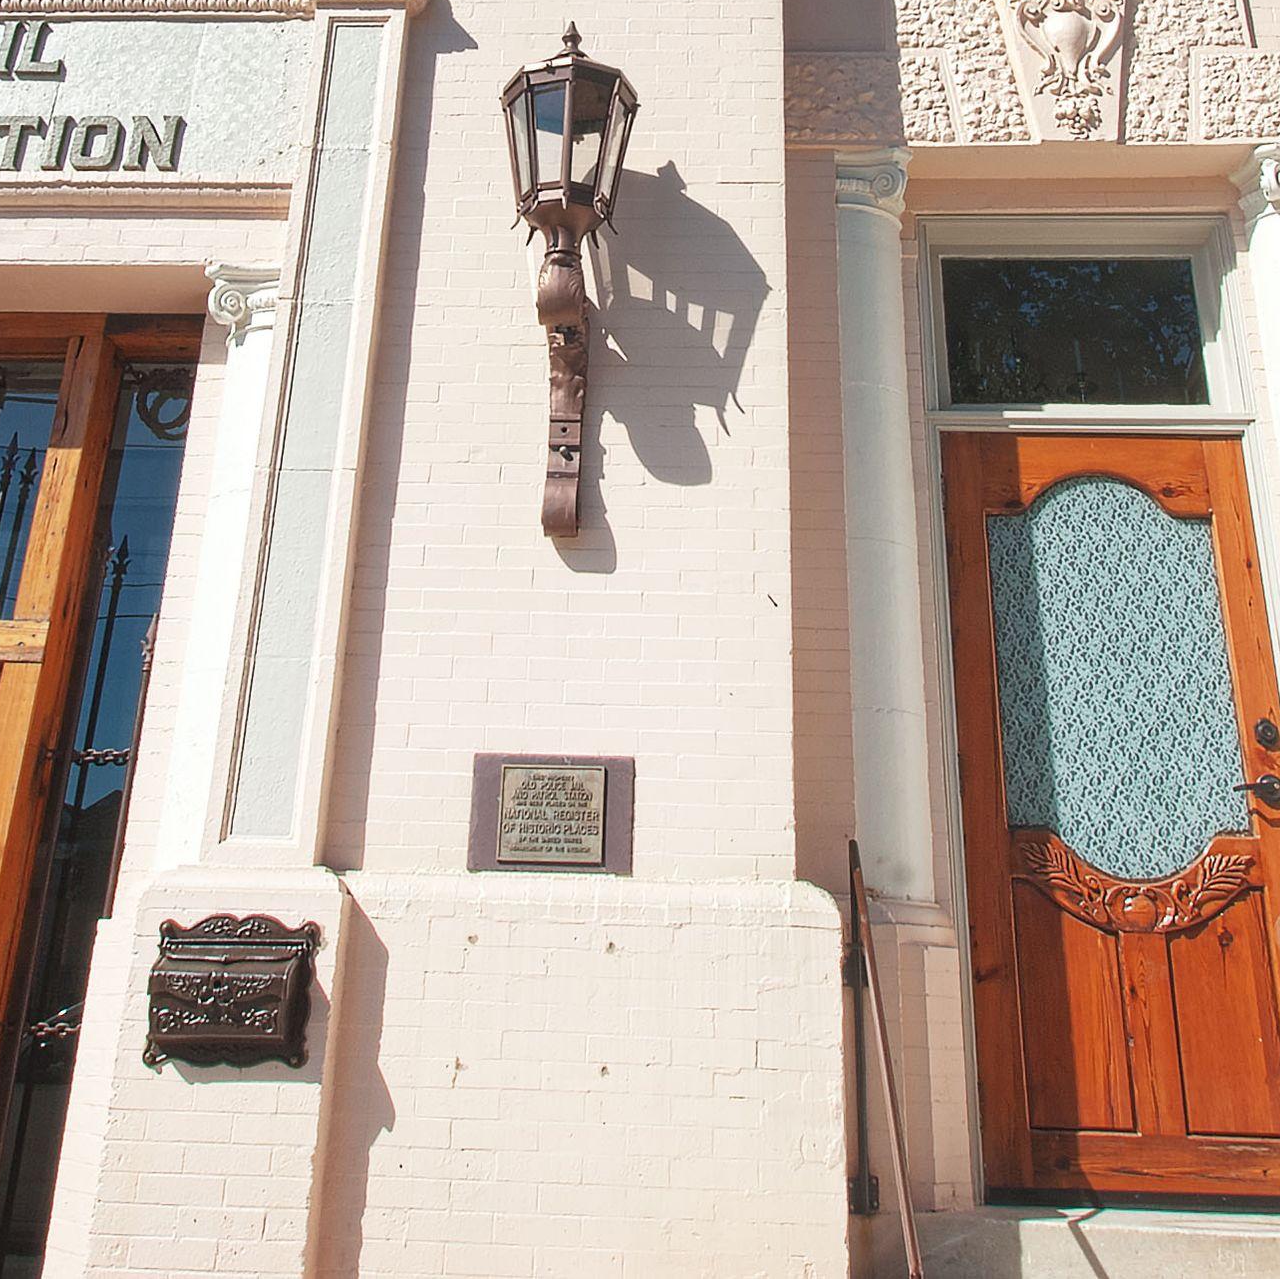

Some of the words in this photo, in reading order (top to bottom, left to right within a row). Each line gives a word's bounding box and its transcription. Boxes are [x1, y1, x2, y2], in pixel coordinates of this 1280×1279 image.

[503, 807, 549, 821] NATIONAL
[553, 810, 600, 822] REGISTER
[503, 823, 516, 834] OF
[518, 822, 561, 835] HISTORIC
[563, 824, 600, 836] PLACES
